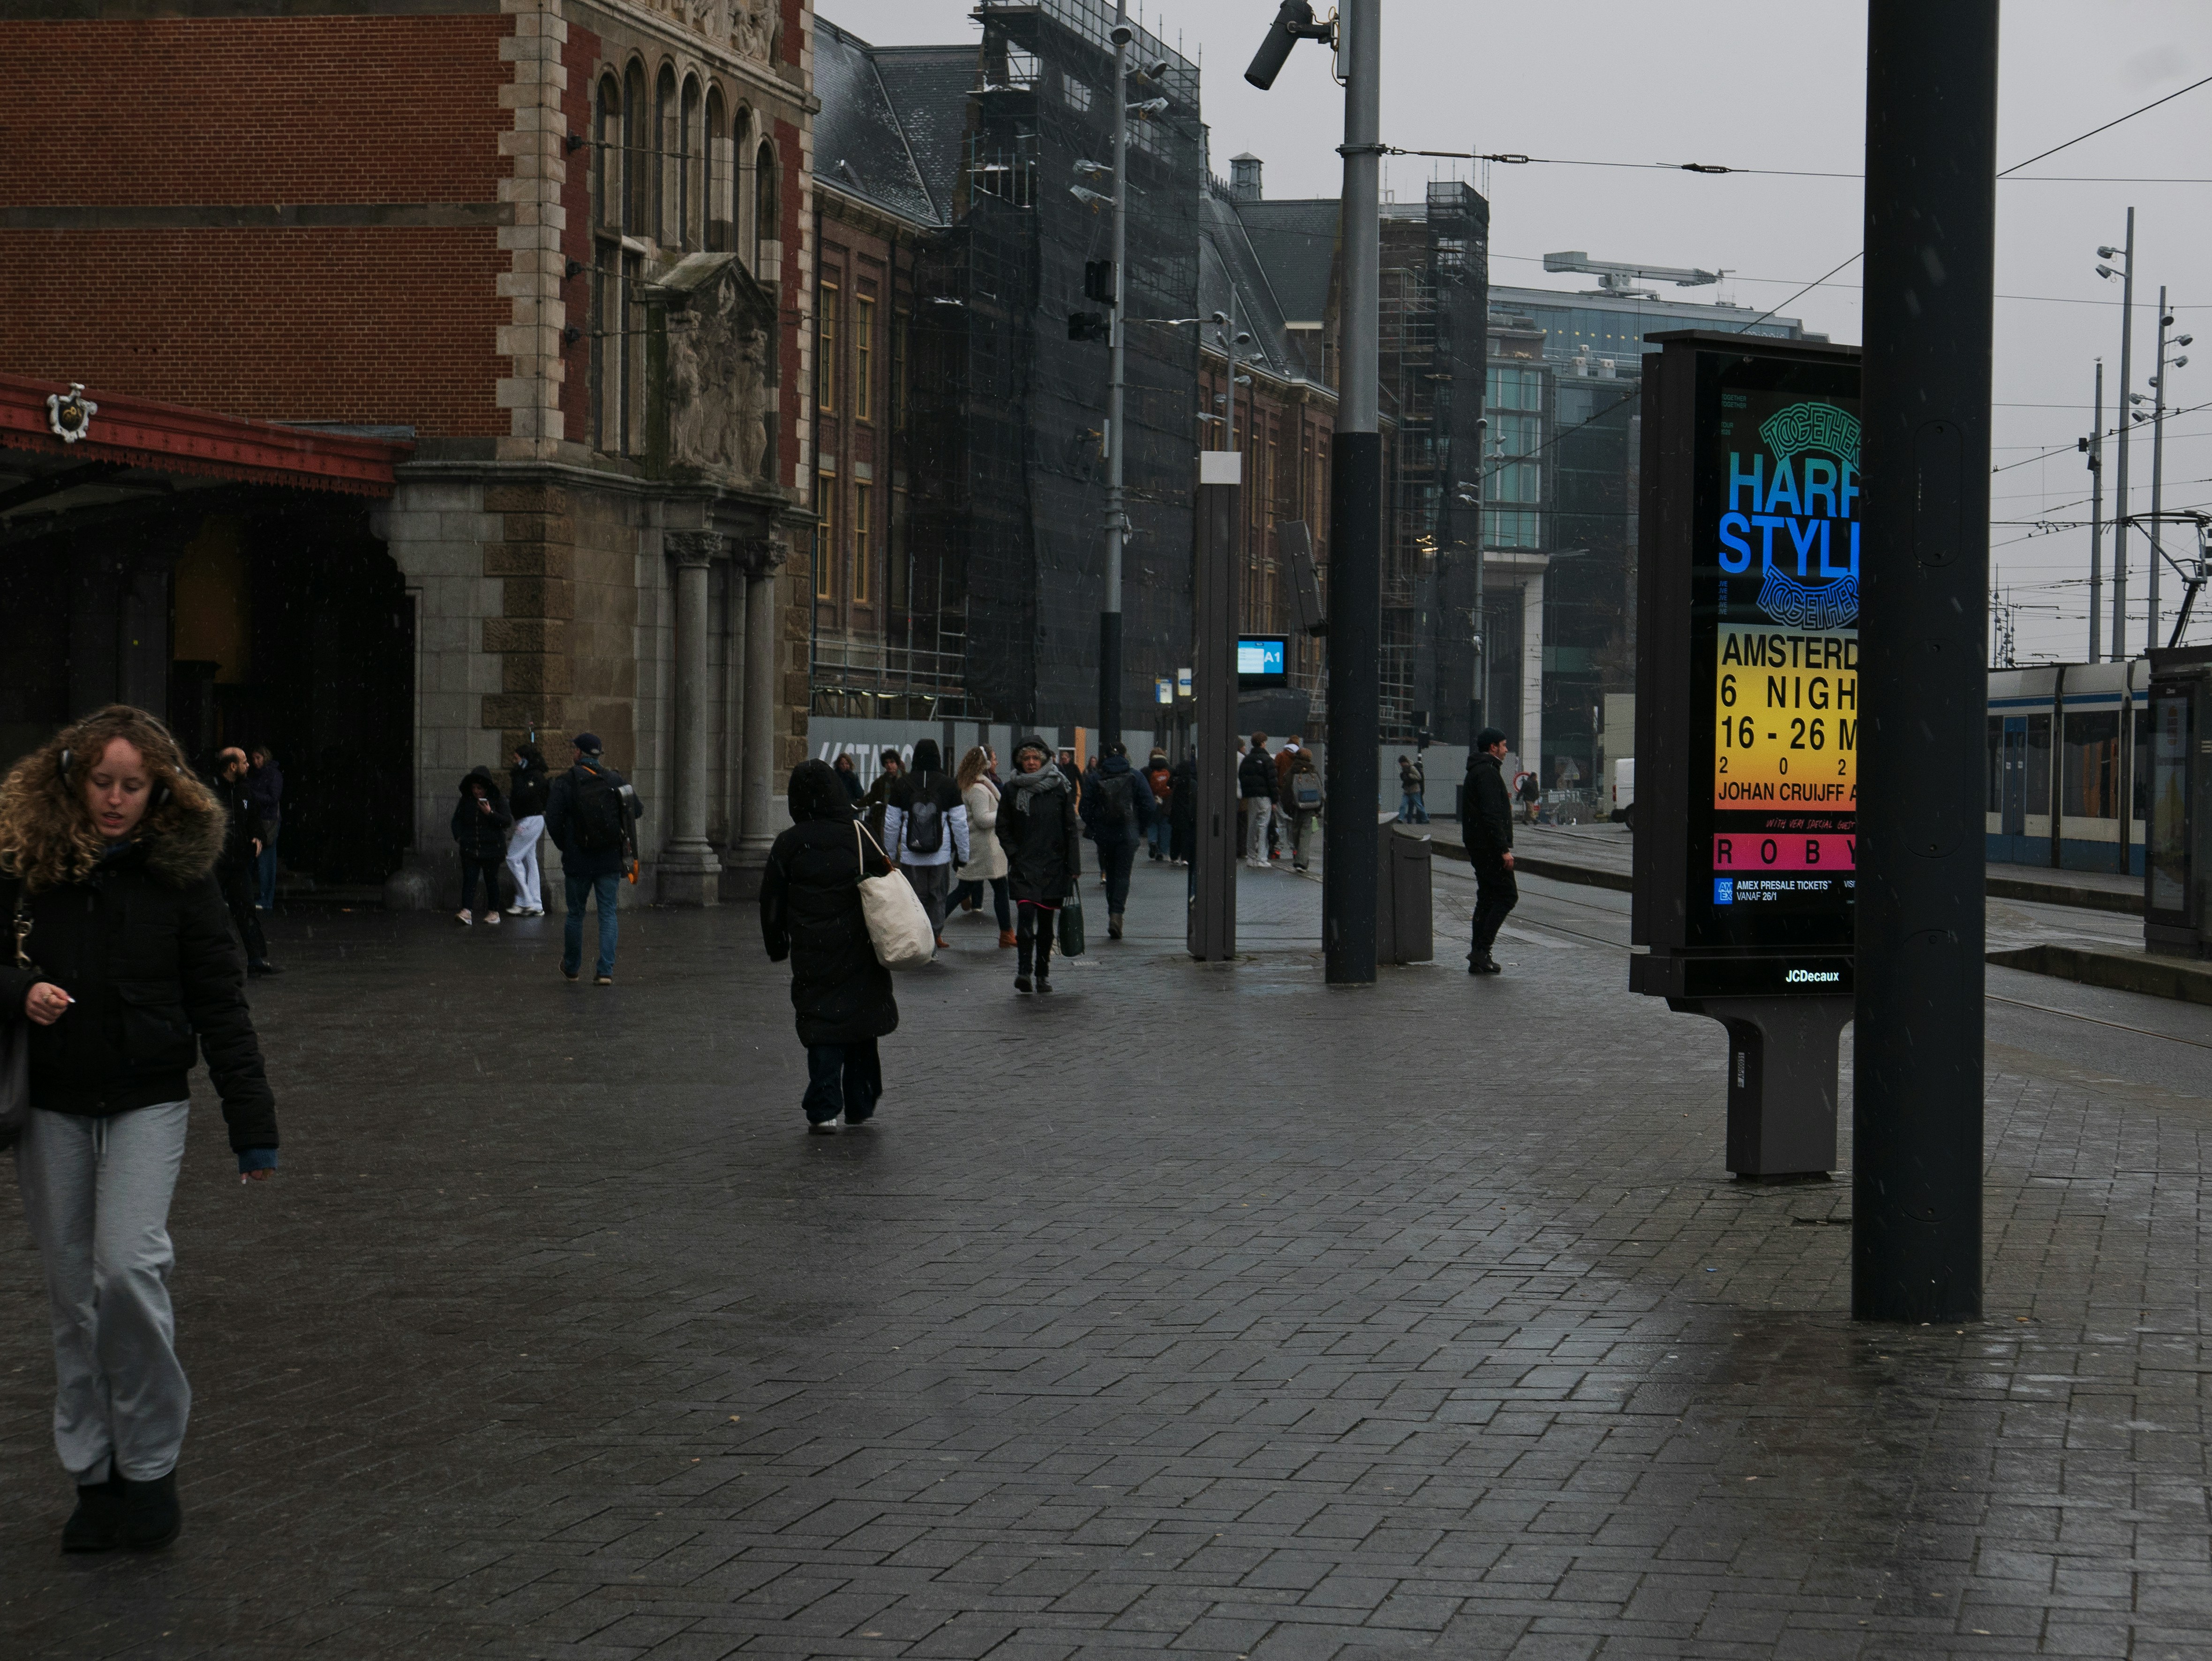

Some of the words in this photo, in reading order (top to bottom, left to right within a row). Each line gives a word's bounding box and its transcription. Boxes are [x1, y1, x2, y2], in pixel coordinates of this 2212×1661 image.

[1264, 651, 1280, 662] A1
[1721, 674, 1737, 708] 6
[1721, 715, 1754, 749] 16
[1790, 717, 1825, 751] 26
[1719, 782, 1774, 801] JOHAN
[1779, 782, 1845, 802] CRUIJFF
[1737, 880, 1759, 890] AMEX
[1761, 880, 1795, 890] PRESALE
[1737, 891, 1761, 901] VANAF
[1762, 891, 1777, 901] 26/1
[1785, 970, 1840, 983] JCDecaux
